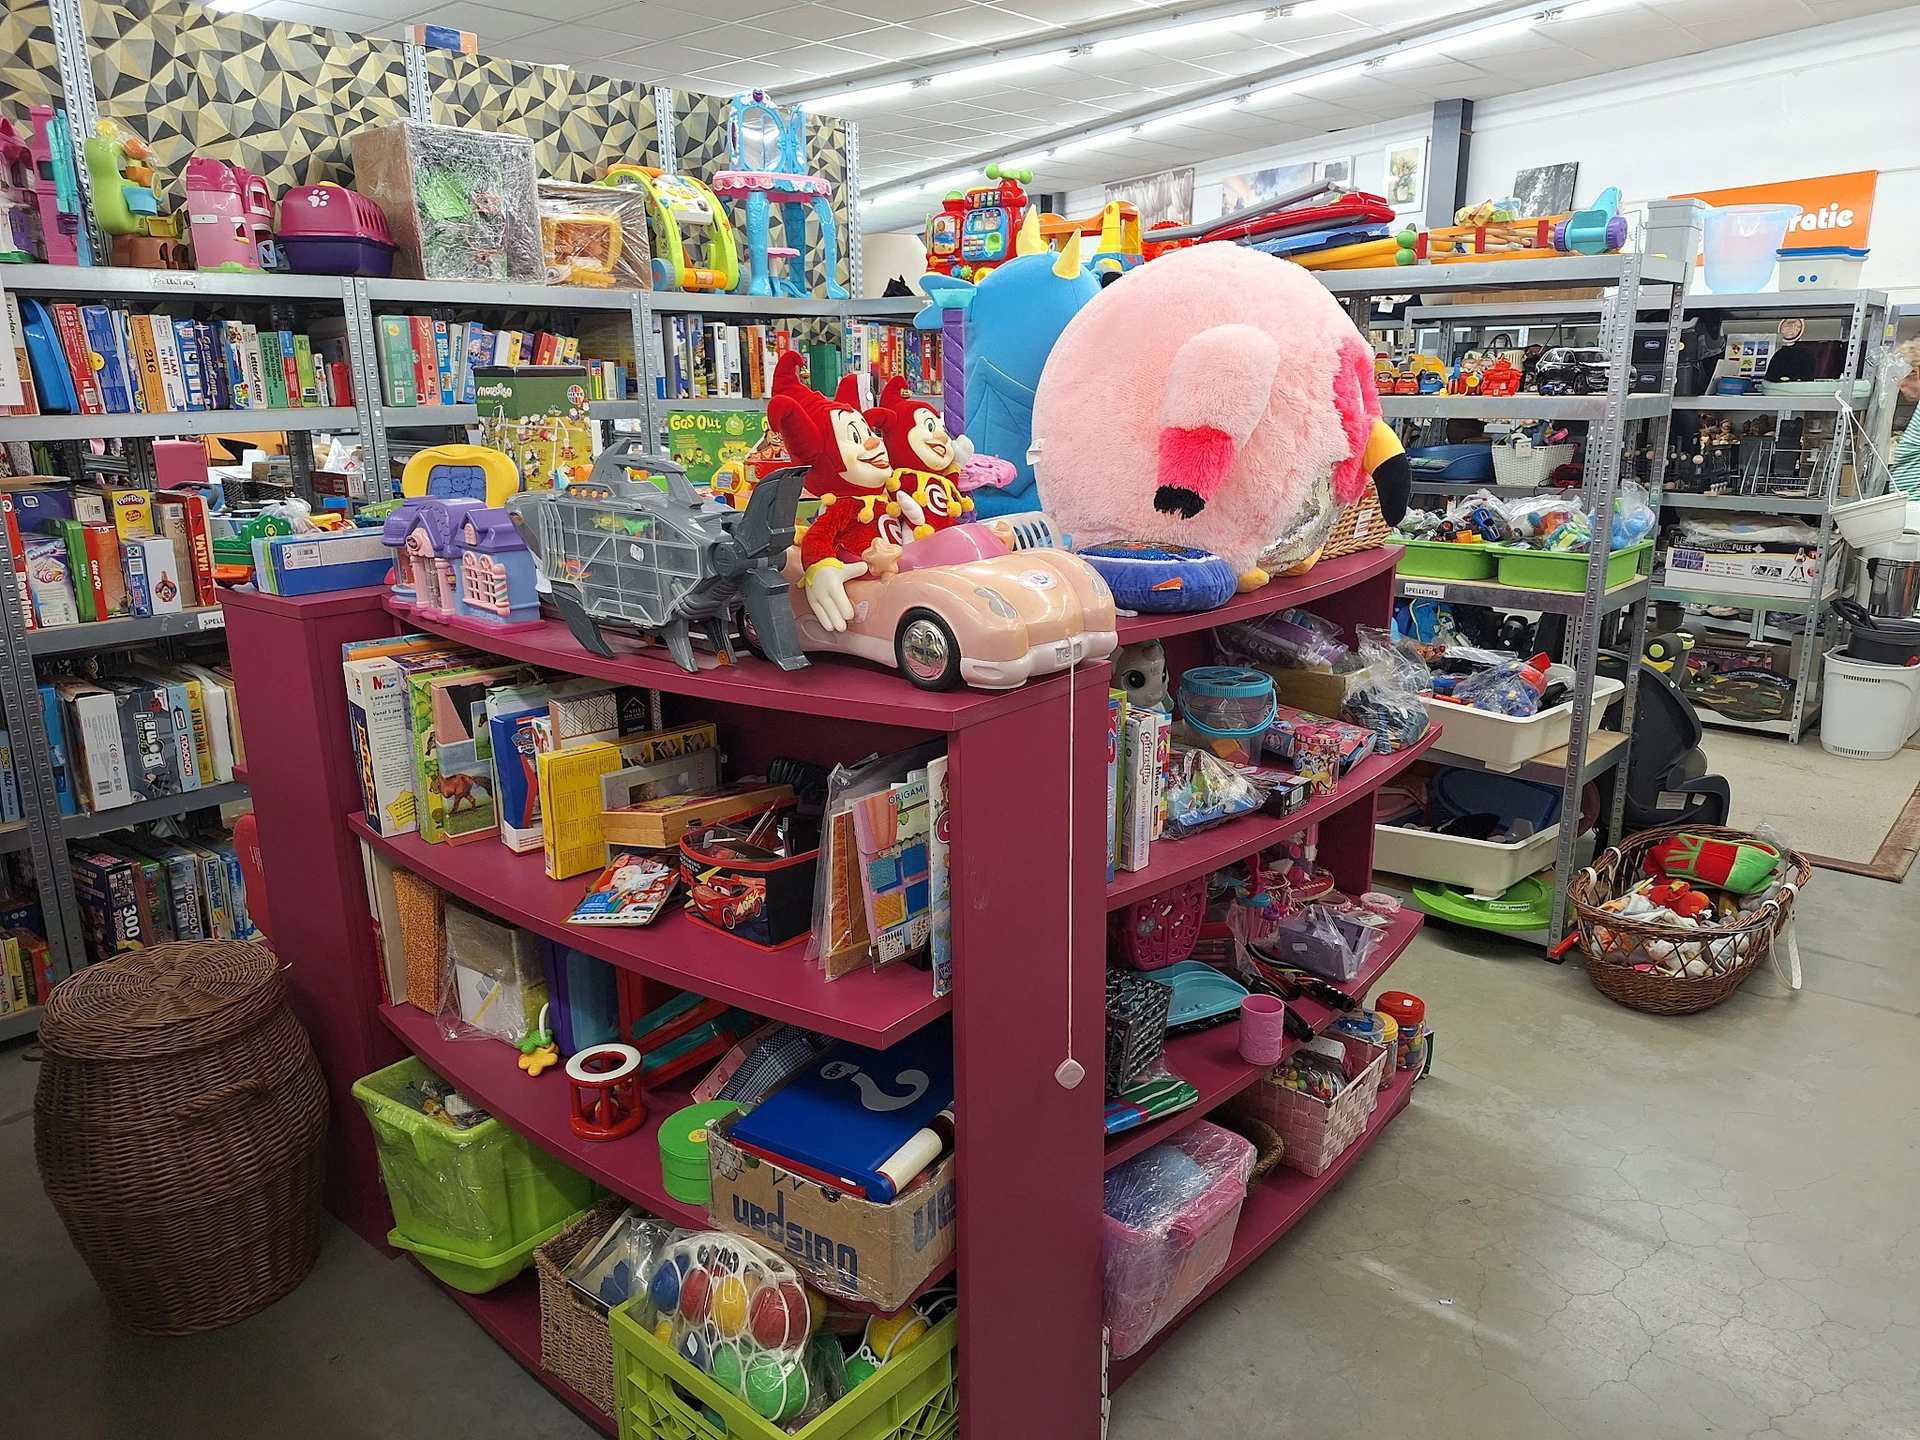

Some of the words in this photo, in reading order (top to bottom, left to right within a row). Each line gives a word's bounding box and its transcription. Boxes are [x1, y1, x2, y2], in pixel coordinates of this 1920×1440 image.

[65, 310, 76, 327] 153
[143, 349, 156, 373] 216
[169, 359, 179, 377] LAAT
[195, 533, 209, 572] HALMA
[1732, 543, 1752, 552] PULSE
[15, 571, 34, 628] Bowling
[180, 734, 193, 777] MONOPOLY
[1157, 725, 1170, 763] K3
[888, 784, 926, 805] ORIGAMI
[1153, 766, 1162, 796] Memo
[123, 904, 140, 938] 300
[184, 884, 200, 934] MONOPOLY
